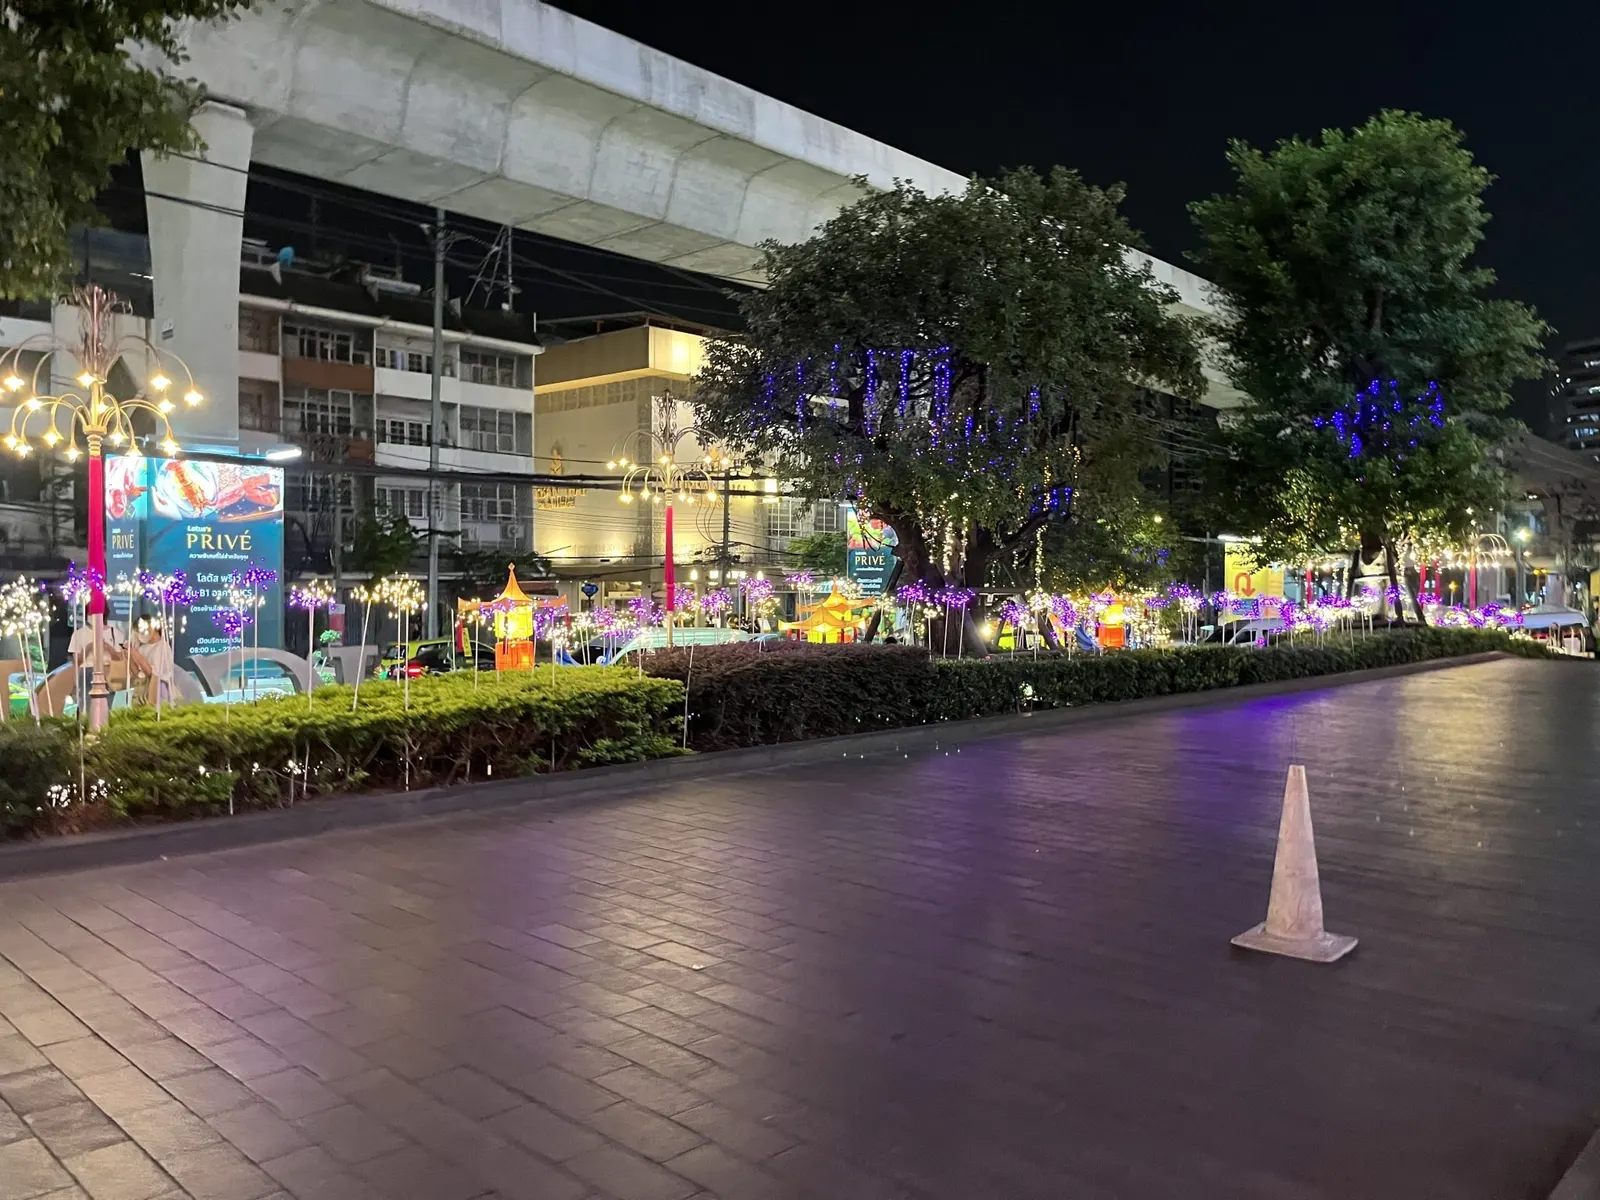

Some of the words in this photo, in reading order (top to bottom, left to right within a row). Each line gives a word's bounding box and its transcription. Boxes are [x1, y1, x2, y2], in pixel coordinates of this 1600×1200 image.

[112, 529, 135, 549] PRIVÉ
[186, 529, 252, 551] PRIVÉ
[855, 553, 886, 566] PRIVÉ
[199, 589, 210, 597] B1
